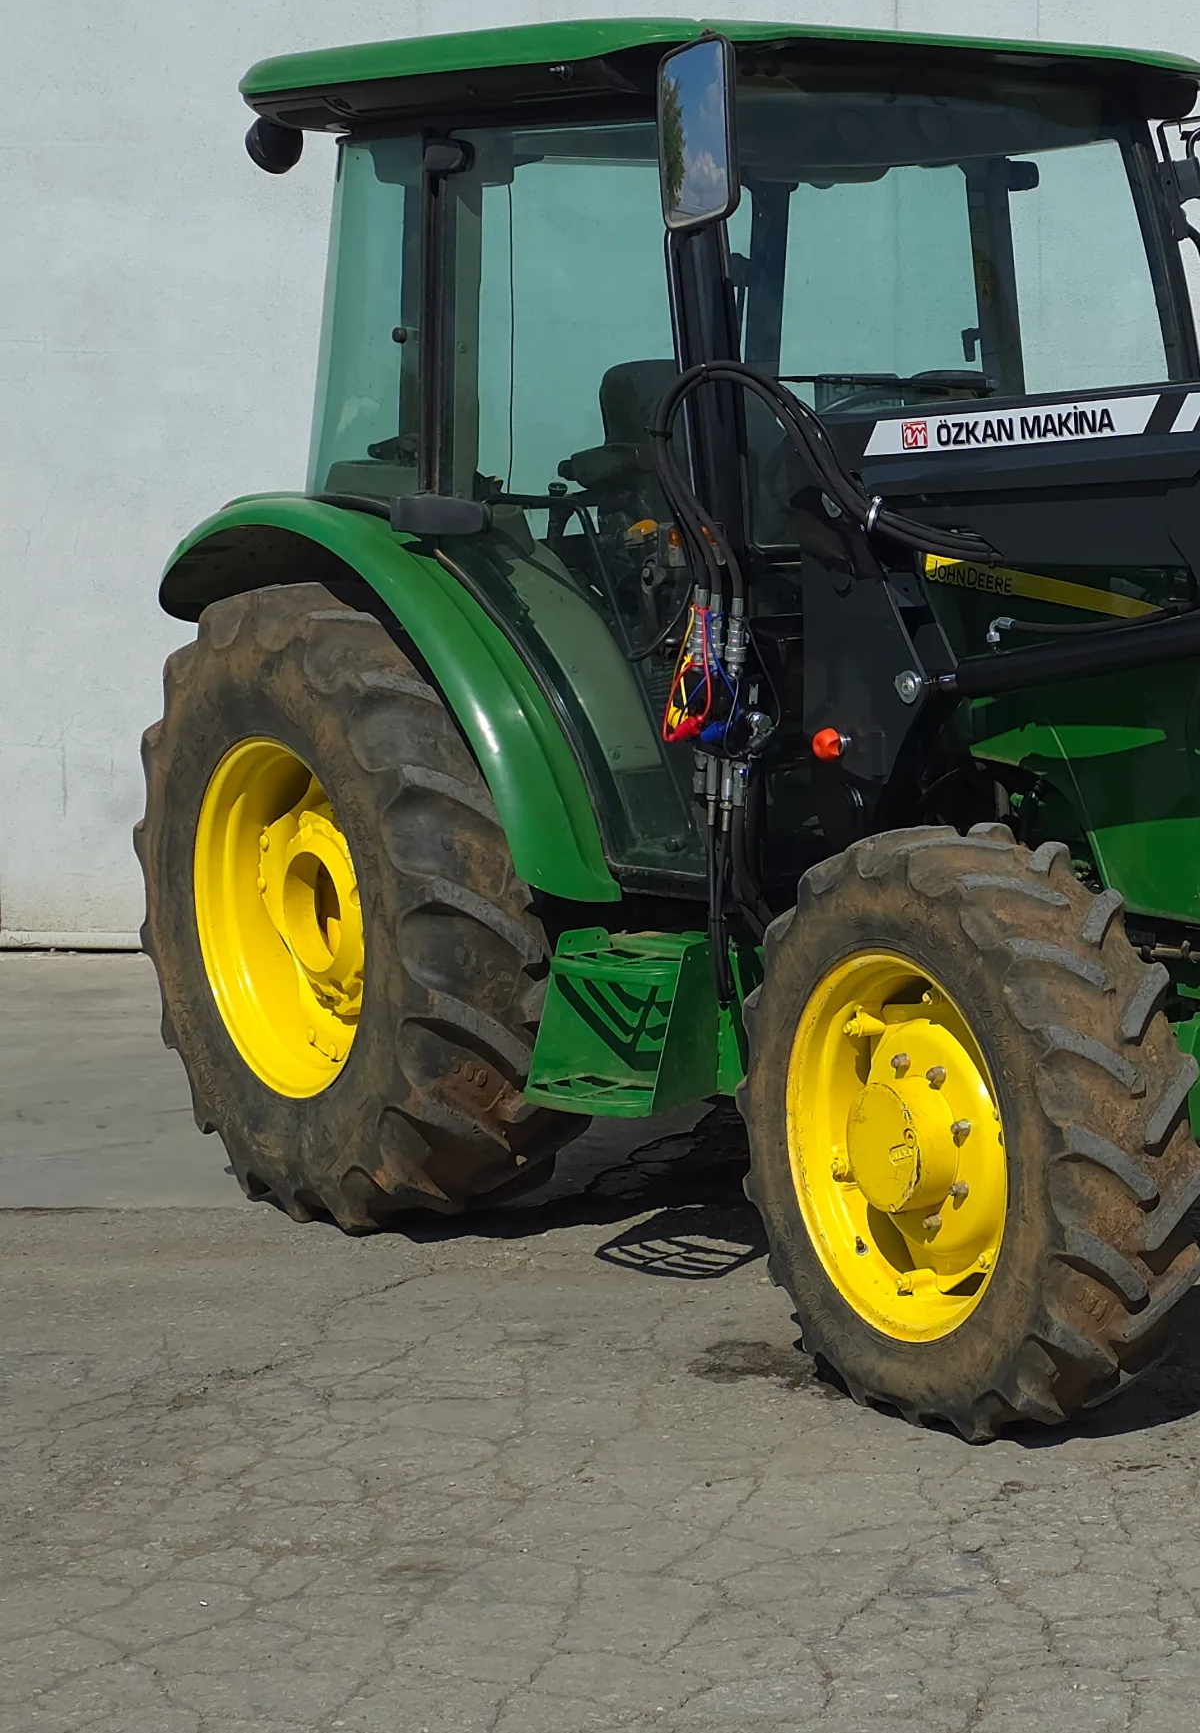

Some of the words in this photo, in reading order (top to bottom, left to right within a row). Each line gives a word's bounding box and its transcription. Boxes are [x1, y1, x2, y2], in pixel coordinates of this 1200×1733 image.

[936, 419, 1015, 446] ÖZKAN
[1020, 405, 1116, 440] MAKİNA
[930, 559, 965, 585] JOHN
[967, 568, 1012, 593] DEERE
